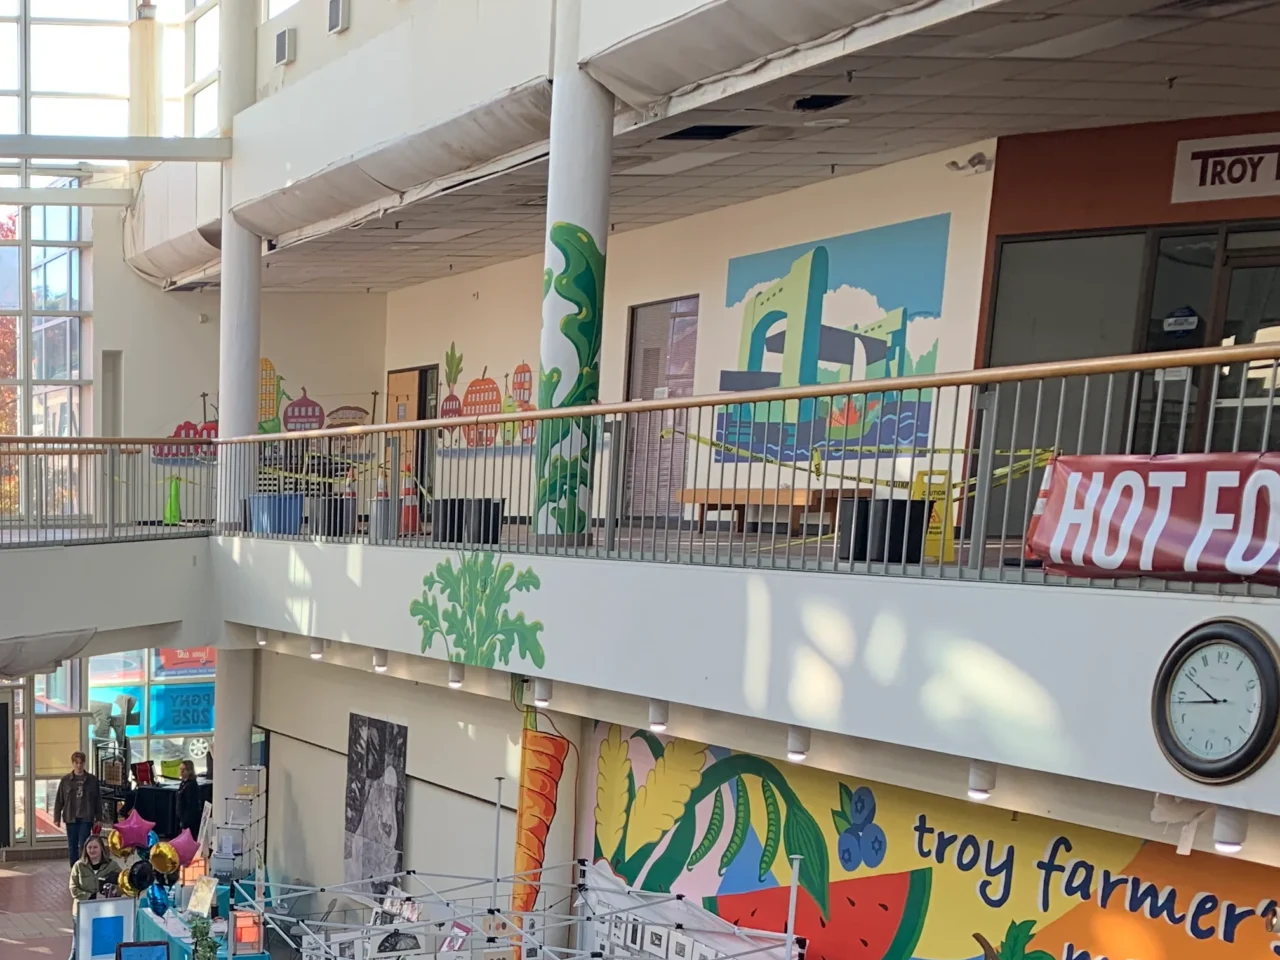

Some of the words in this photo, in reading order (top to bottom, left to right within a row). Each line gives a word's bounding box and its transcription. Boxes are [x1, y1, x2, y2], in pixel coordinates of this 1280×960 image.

[1190, 146, 1265, 187] TROY
[1049, 470, 1186, 571] HOT
[1218, 651, 1229, 664] 12
[1236, 660, 1243, 671] 1
[914, 814, 1015, 908] troy
[1036, 836, 1280, 957] farmer'
